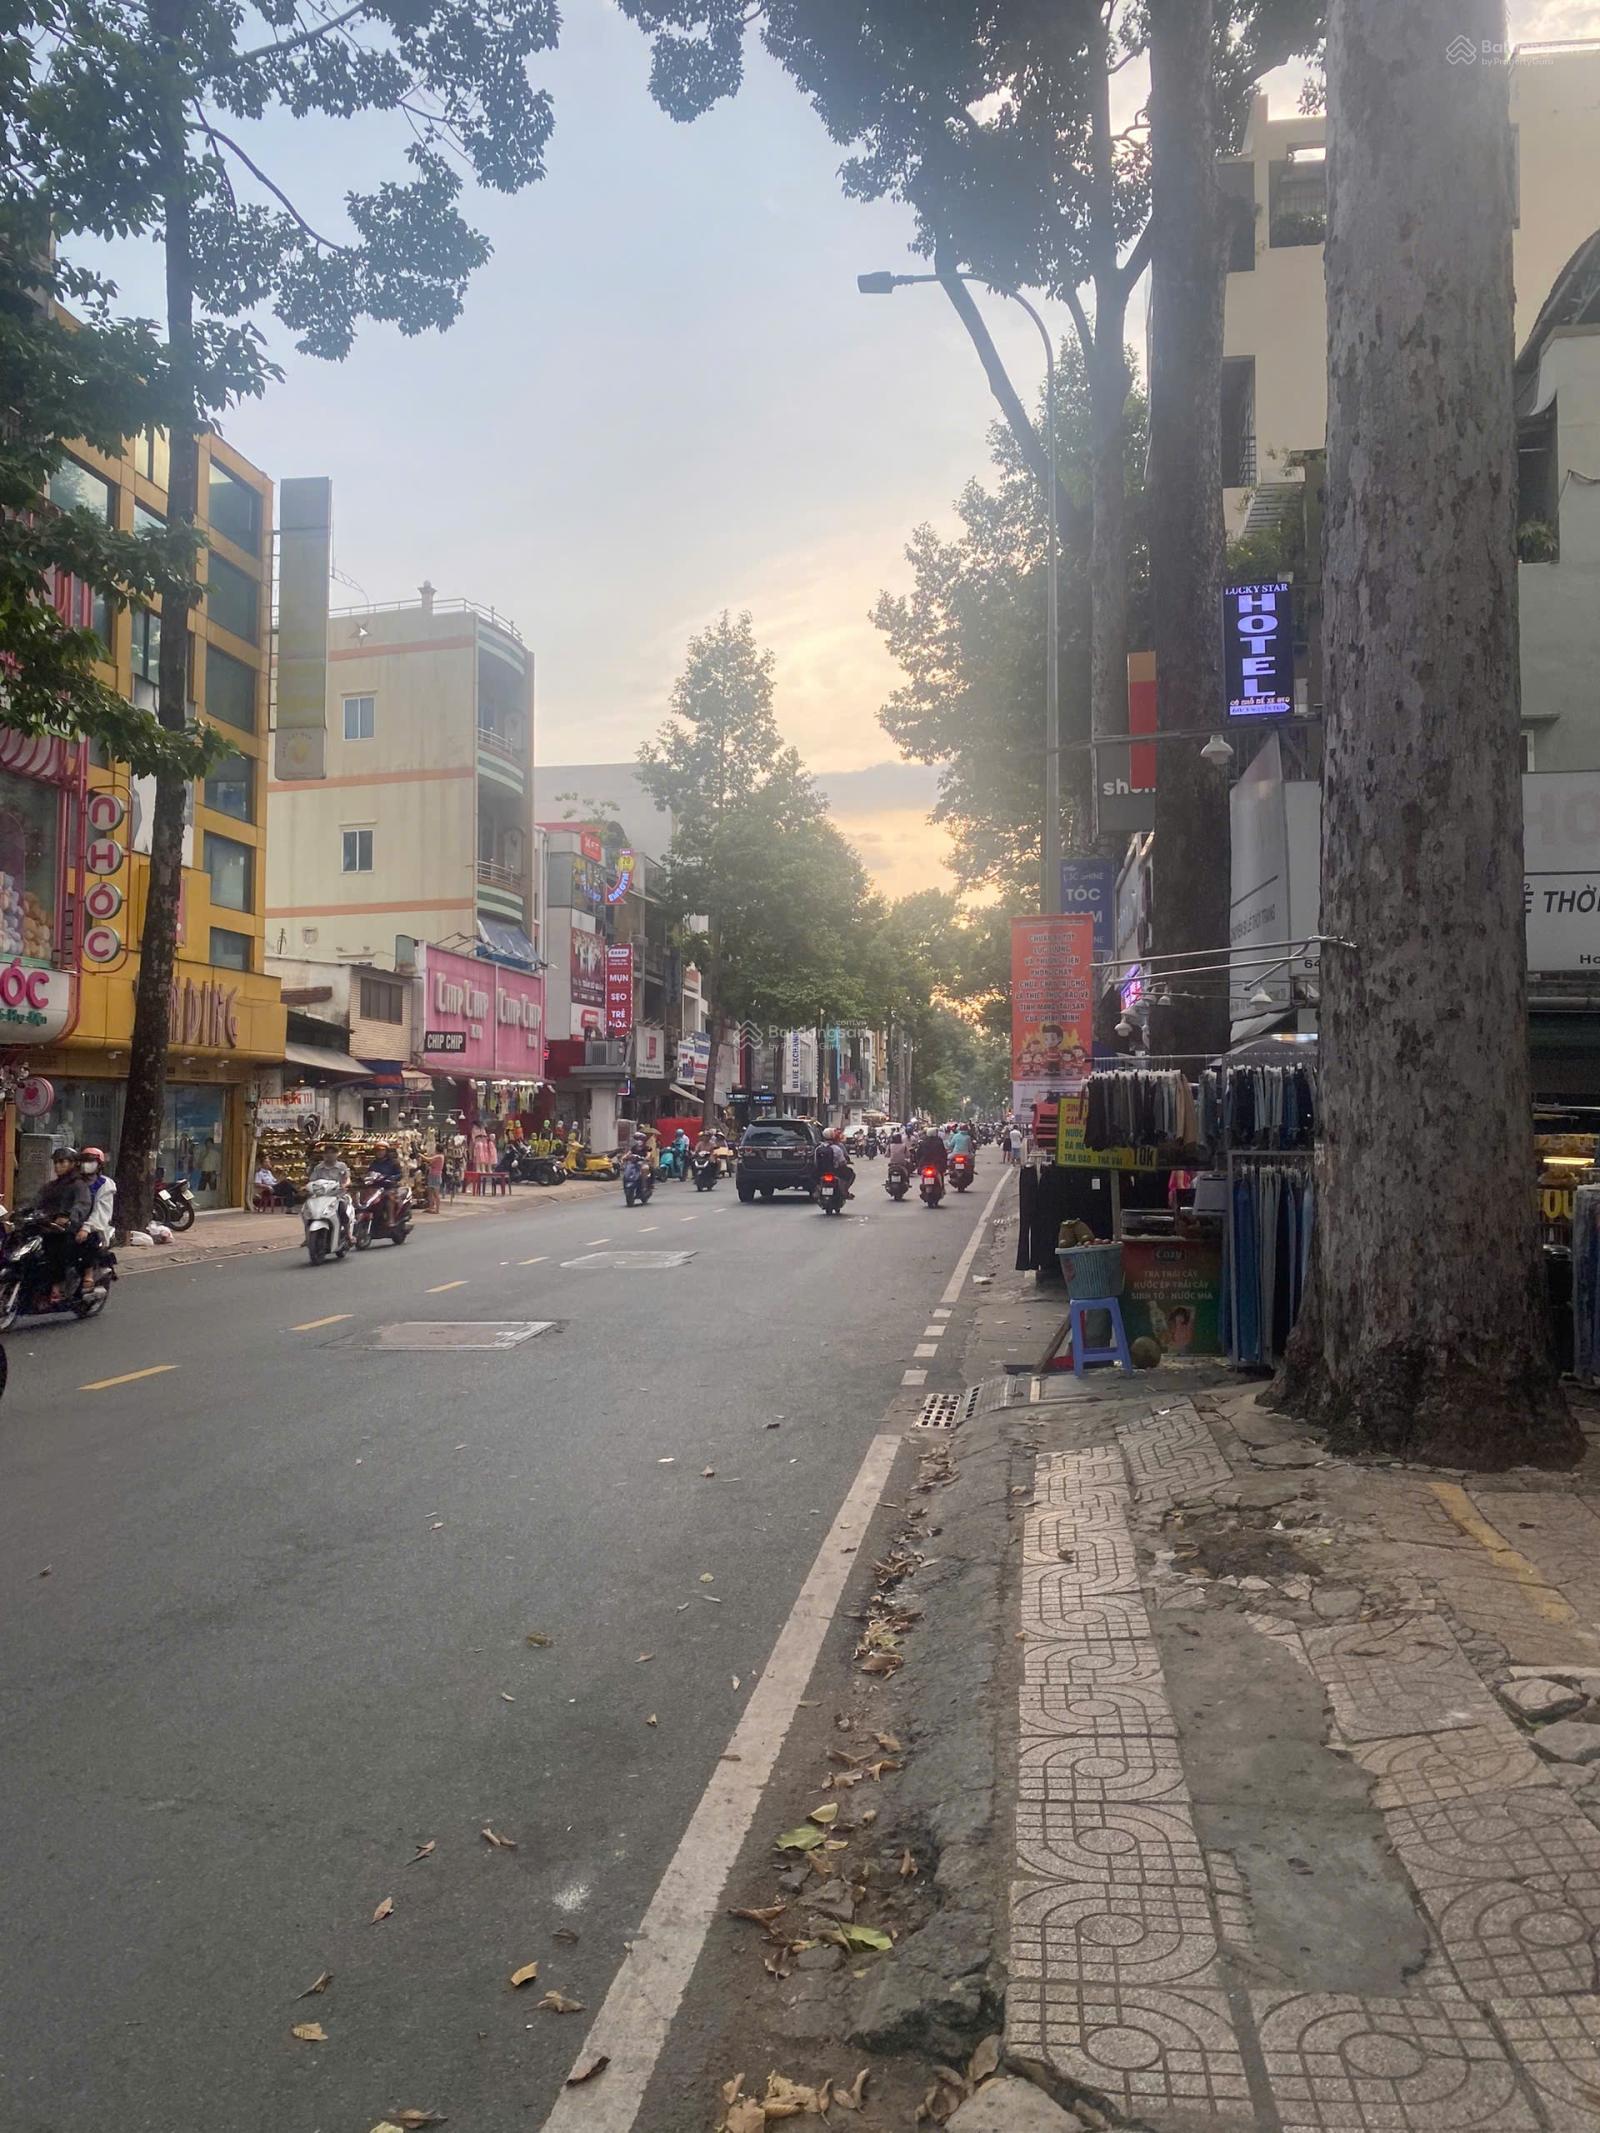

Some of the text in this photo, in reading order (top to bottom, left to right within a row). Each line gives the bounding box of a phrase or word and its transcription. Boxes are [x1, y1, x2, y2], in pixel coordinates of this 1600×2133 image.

[1225, 583, 1288, 595] LUCKY STAR
[1237, 593, 1278, 697] HOTEL
[1066, 884, 1101, 902] TÓC
[1543, 884, 1600, 913] THỜ
[0, 957, 49, 1010] ÓC
[609, 974, 629, 984] MỤN
[610, 993, 627, 1002] SẸO
[427, 1033, 463, 1050] CHIP CHIP
[792, 1067, 800, 1089] BLUE
